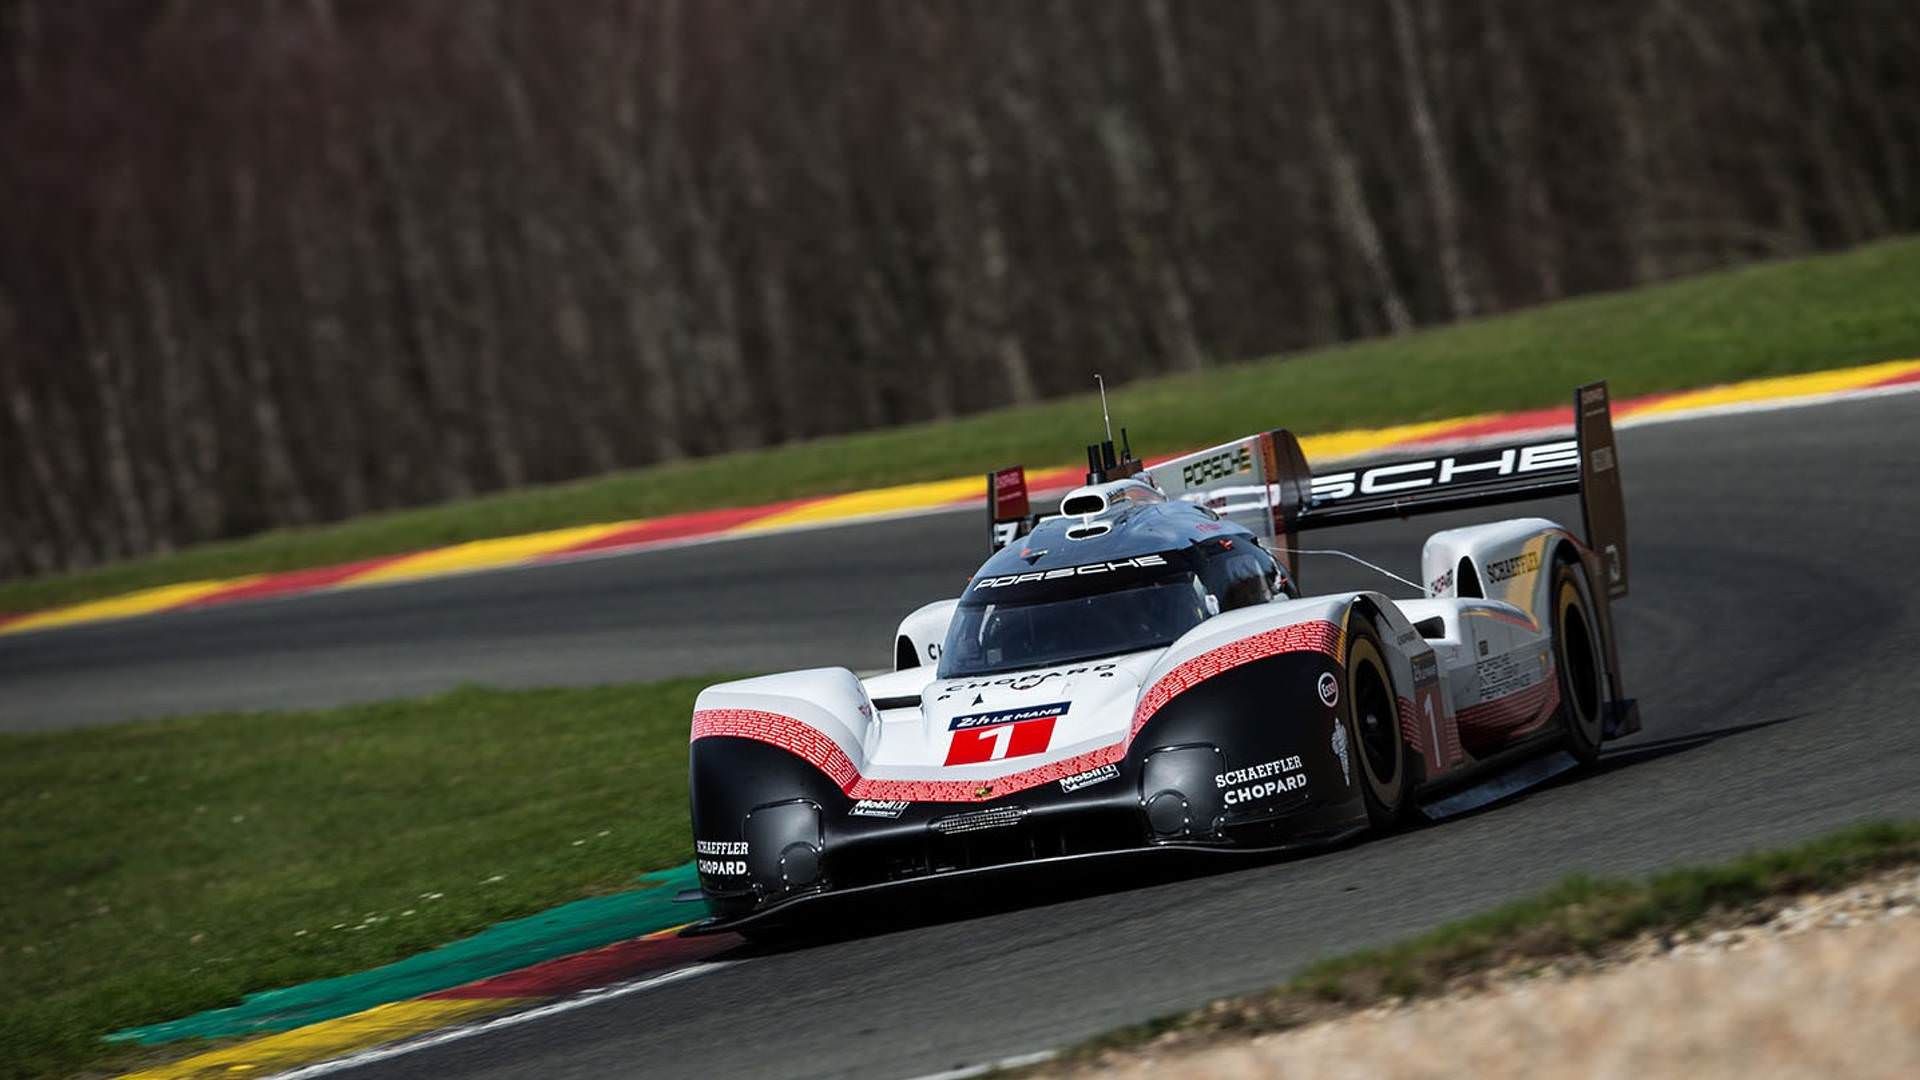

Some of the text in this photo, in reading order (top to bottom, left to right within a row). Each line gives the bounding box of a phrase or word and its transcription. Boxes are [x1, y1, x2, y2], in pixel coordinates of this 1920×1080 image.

[1183, 446, 1251, 489] PORSCHE
[973, 554, 1168, 592] PORSCHE
[945, 664, 1115, 691] CHOPARD
[1321, 682, 1336, 699] Esso
[956, 706, 1062, 729] 24h LE MANS
[1423, 693, 1441, 769] 1
[978, 724, 1014, 761] 1
[1059, 768, 1102, 787] Mobil
[1215, 755, 1303, 789] SCHAEFFLER
[855, 799, 897, 809] Mobil
[1223, 773, 1308, 806] CHOPARD
[698, 860, 747, 876] CHOPARD
